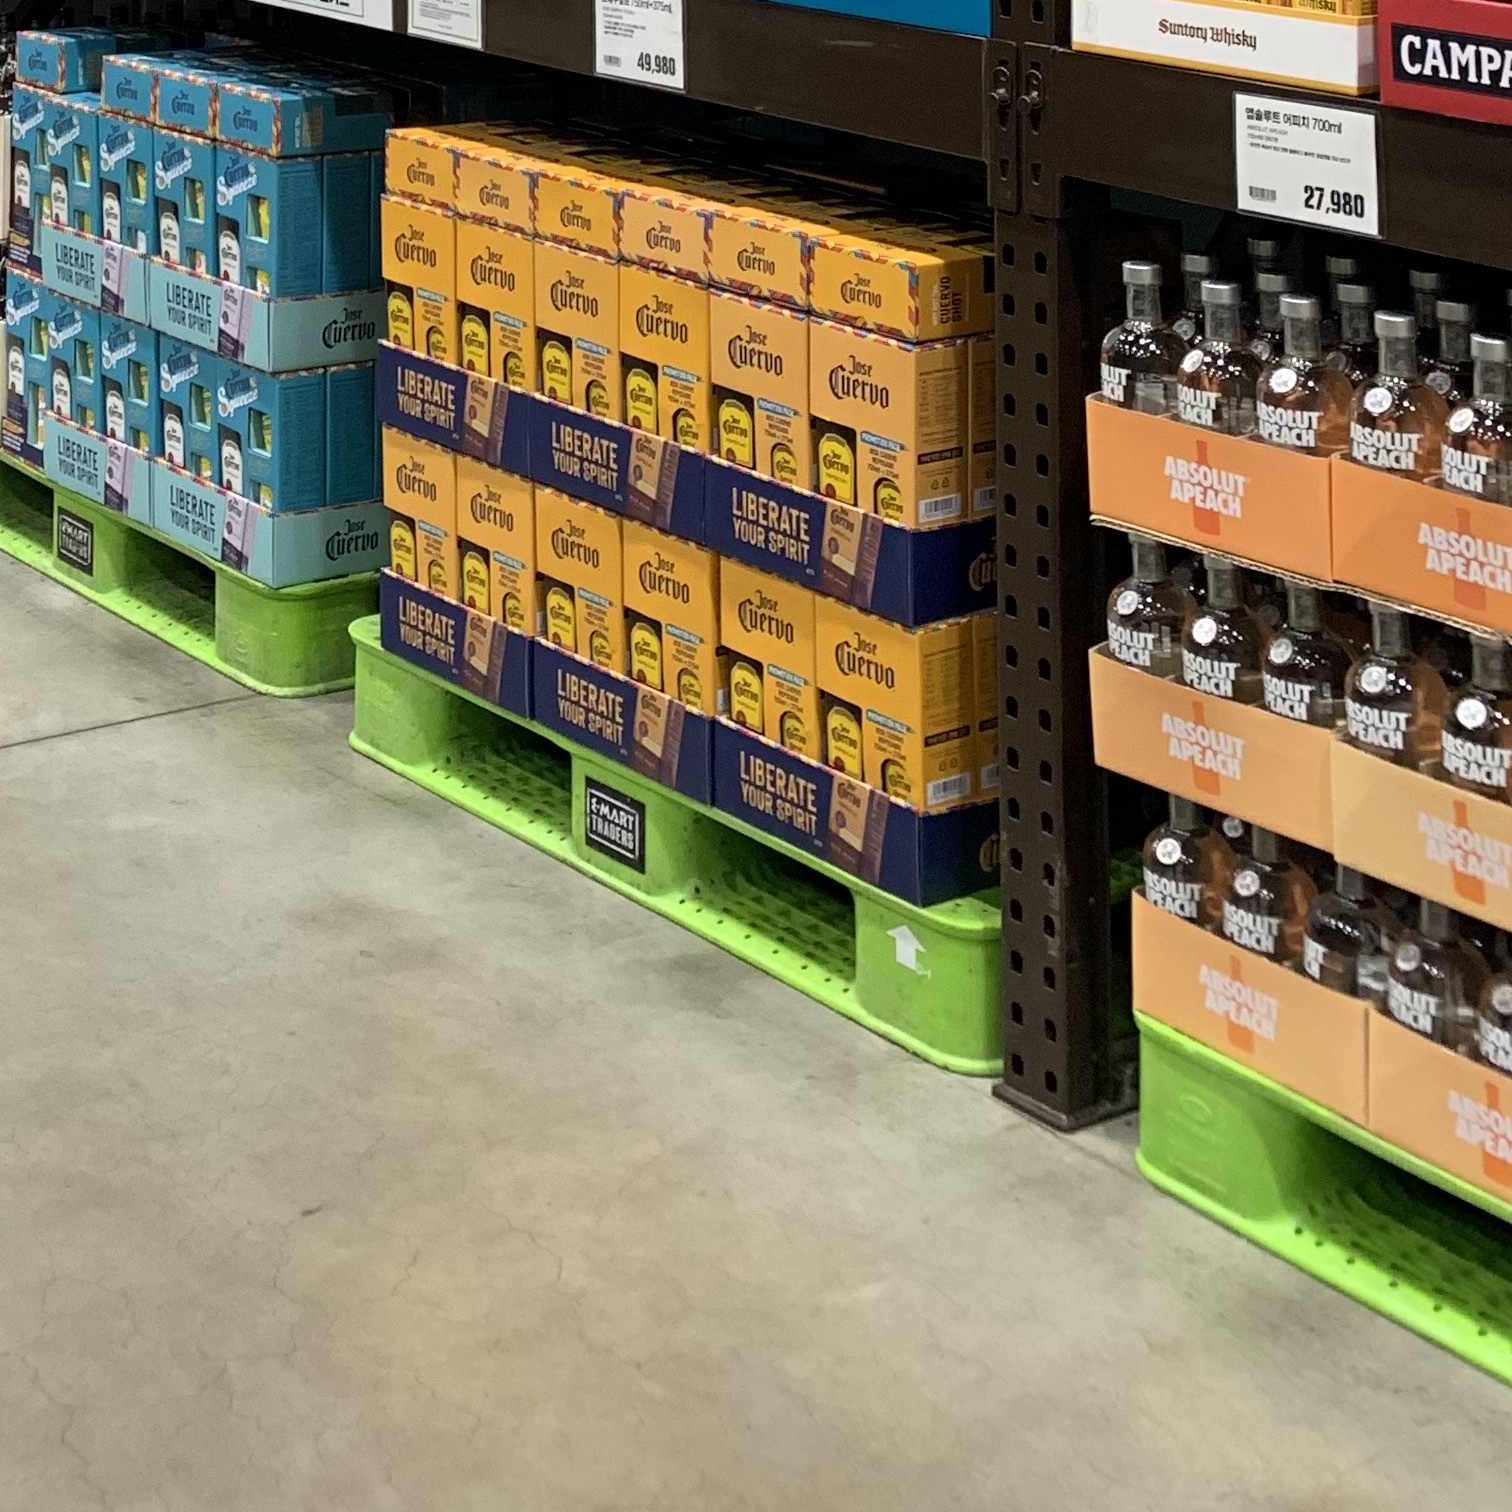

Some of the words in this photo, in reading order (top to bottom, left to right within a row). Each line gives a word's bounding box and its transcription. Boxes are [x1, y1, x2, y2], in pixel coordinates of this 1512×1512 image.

[1158, 19, 1207, 43] Suntory
[1210, 25, 1257, 52] Whisky
[637, 52, 676, 76] 49,980
[1283, 113, 1310, 130] 어피치
[1311, 117, 1343, 134] 700ml
[1304, 185, 1365, 219] 27,980
[395, 230, 437, 268] Cuervo
[408, 224, 425, 241] Jose
[471, 253, 515, 292] Cuervo
[485, 246, 503, 264] Jose
[166, 282, 212, 315] LIBERATE
[550, 279, 599, 319] Cuervo
[566, 270, 585, 289] Jose
[167, 306, 188, 329] YOUR
[188, 312, 212, 336] SPIRIT
[342, 307, 363, 323] Jose
[636, 304, 688, 344] Cuervo
[653, 295, 673, 316] Jose
[322, 319, 375, 349] Cuervo
[745, 325, 767, 346] Jose
[728, 334, 784, 377] Cuervo
[849, 355, 873, 377] Jose
[397, 366, 456, 402] LIBERATE
[829, 364, 889, 409] Cuervo
[397, 395, 422, 421] YOUR
[423, 402, 456, 430] SPIRIT
[551, 421, 619, 470] LIBERATE
[552, 449, 581, 480] YOUR
[582, 460, 619, 492] SPIRIT
[1164, 456, 1246, 497] ABSOLUT
[732, 488, 810, 542] LIBERATE
[1170, 479, 1242, 519] APEACH
[732, 516, 766, 550] YOUR
[768, 527, 810, 566] SPIRIT
[1418, 522, 1512, 569] ABSOLUT
[1426, 547, 1512, 595] APEACH
[1161, 711, 1244, 759] ABSOLUT
[1169, 738, 1241, 781] APEACH
[740, 752, 817, 813] LIBERATE
[741, 781, 774, 817] YOUR
[776, 794, 817, 836] SPIRIT
[592, 815, 634, 850] TRADERS
[1199, 963, 1279, 1016] ABSOLUT
[1204, 990, 1276, 1042] APEACH
